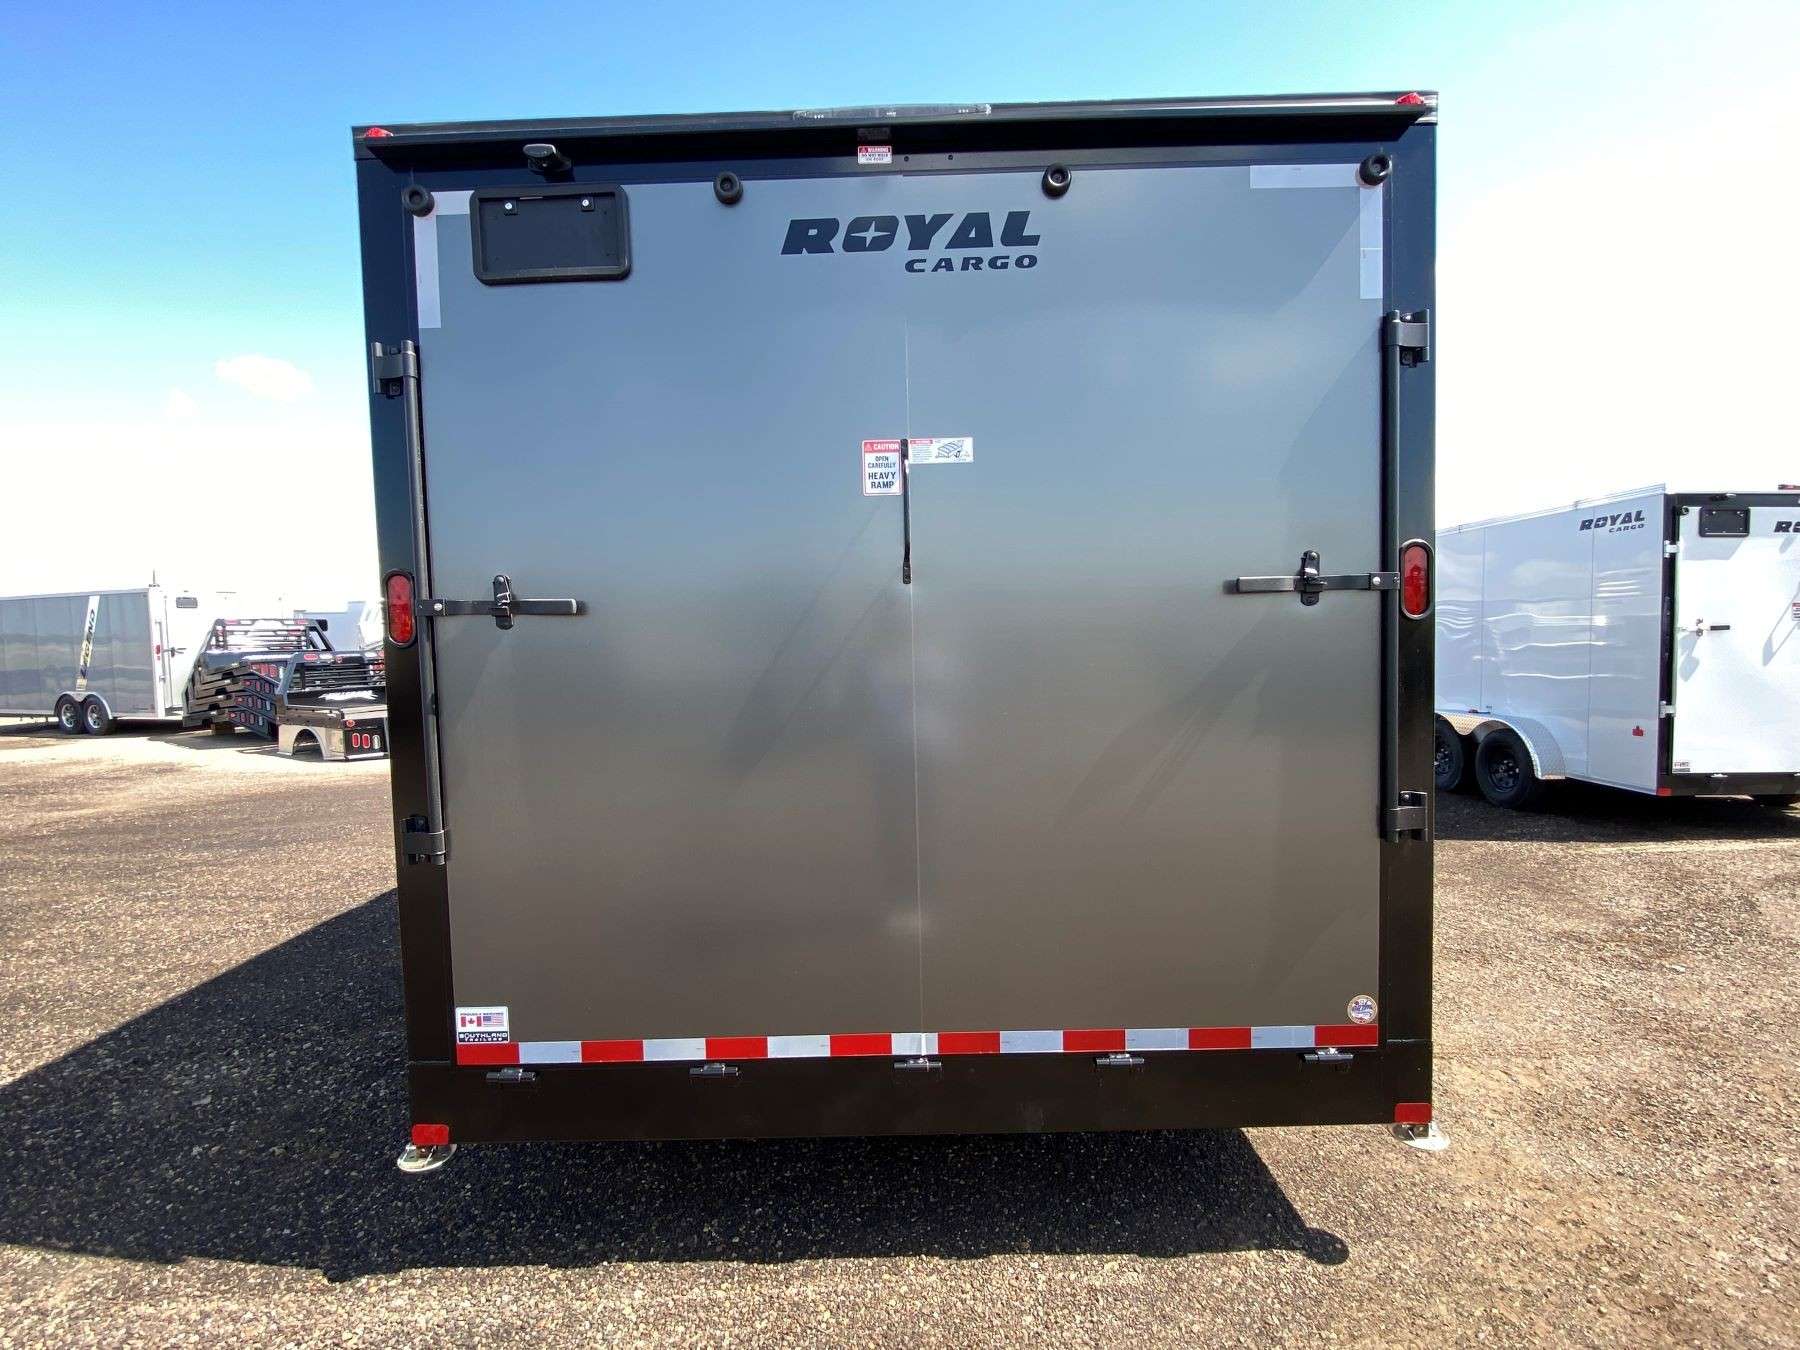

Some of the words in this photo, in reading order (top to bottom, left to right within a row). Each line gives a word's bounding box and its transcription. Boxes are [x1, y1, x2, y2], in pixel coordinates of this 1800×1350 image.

[781, 211, 1041, 255] ROYAL
[904, 254, 1038, 273] CARGO
[868, 472, 896, 480] HEAVY
[871, 481, 894, 489] RAMP
[1579, 510, 1645, 531] ROYAL
[1609, 524, 1644, 532] CARGO
